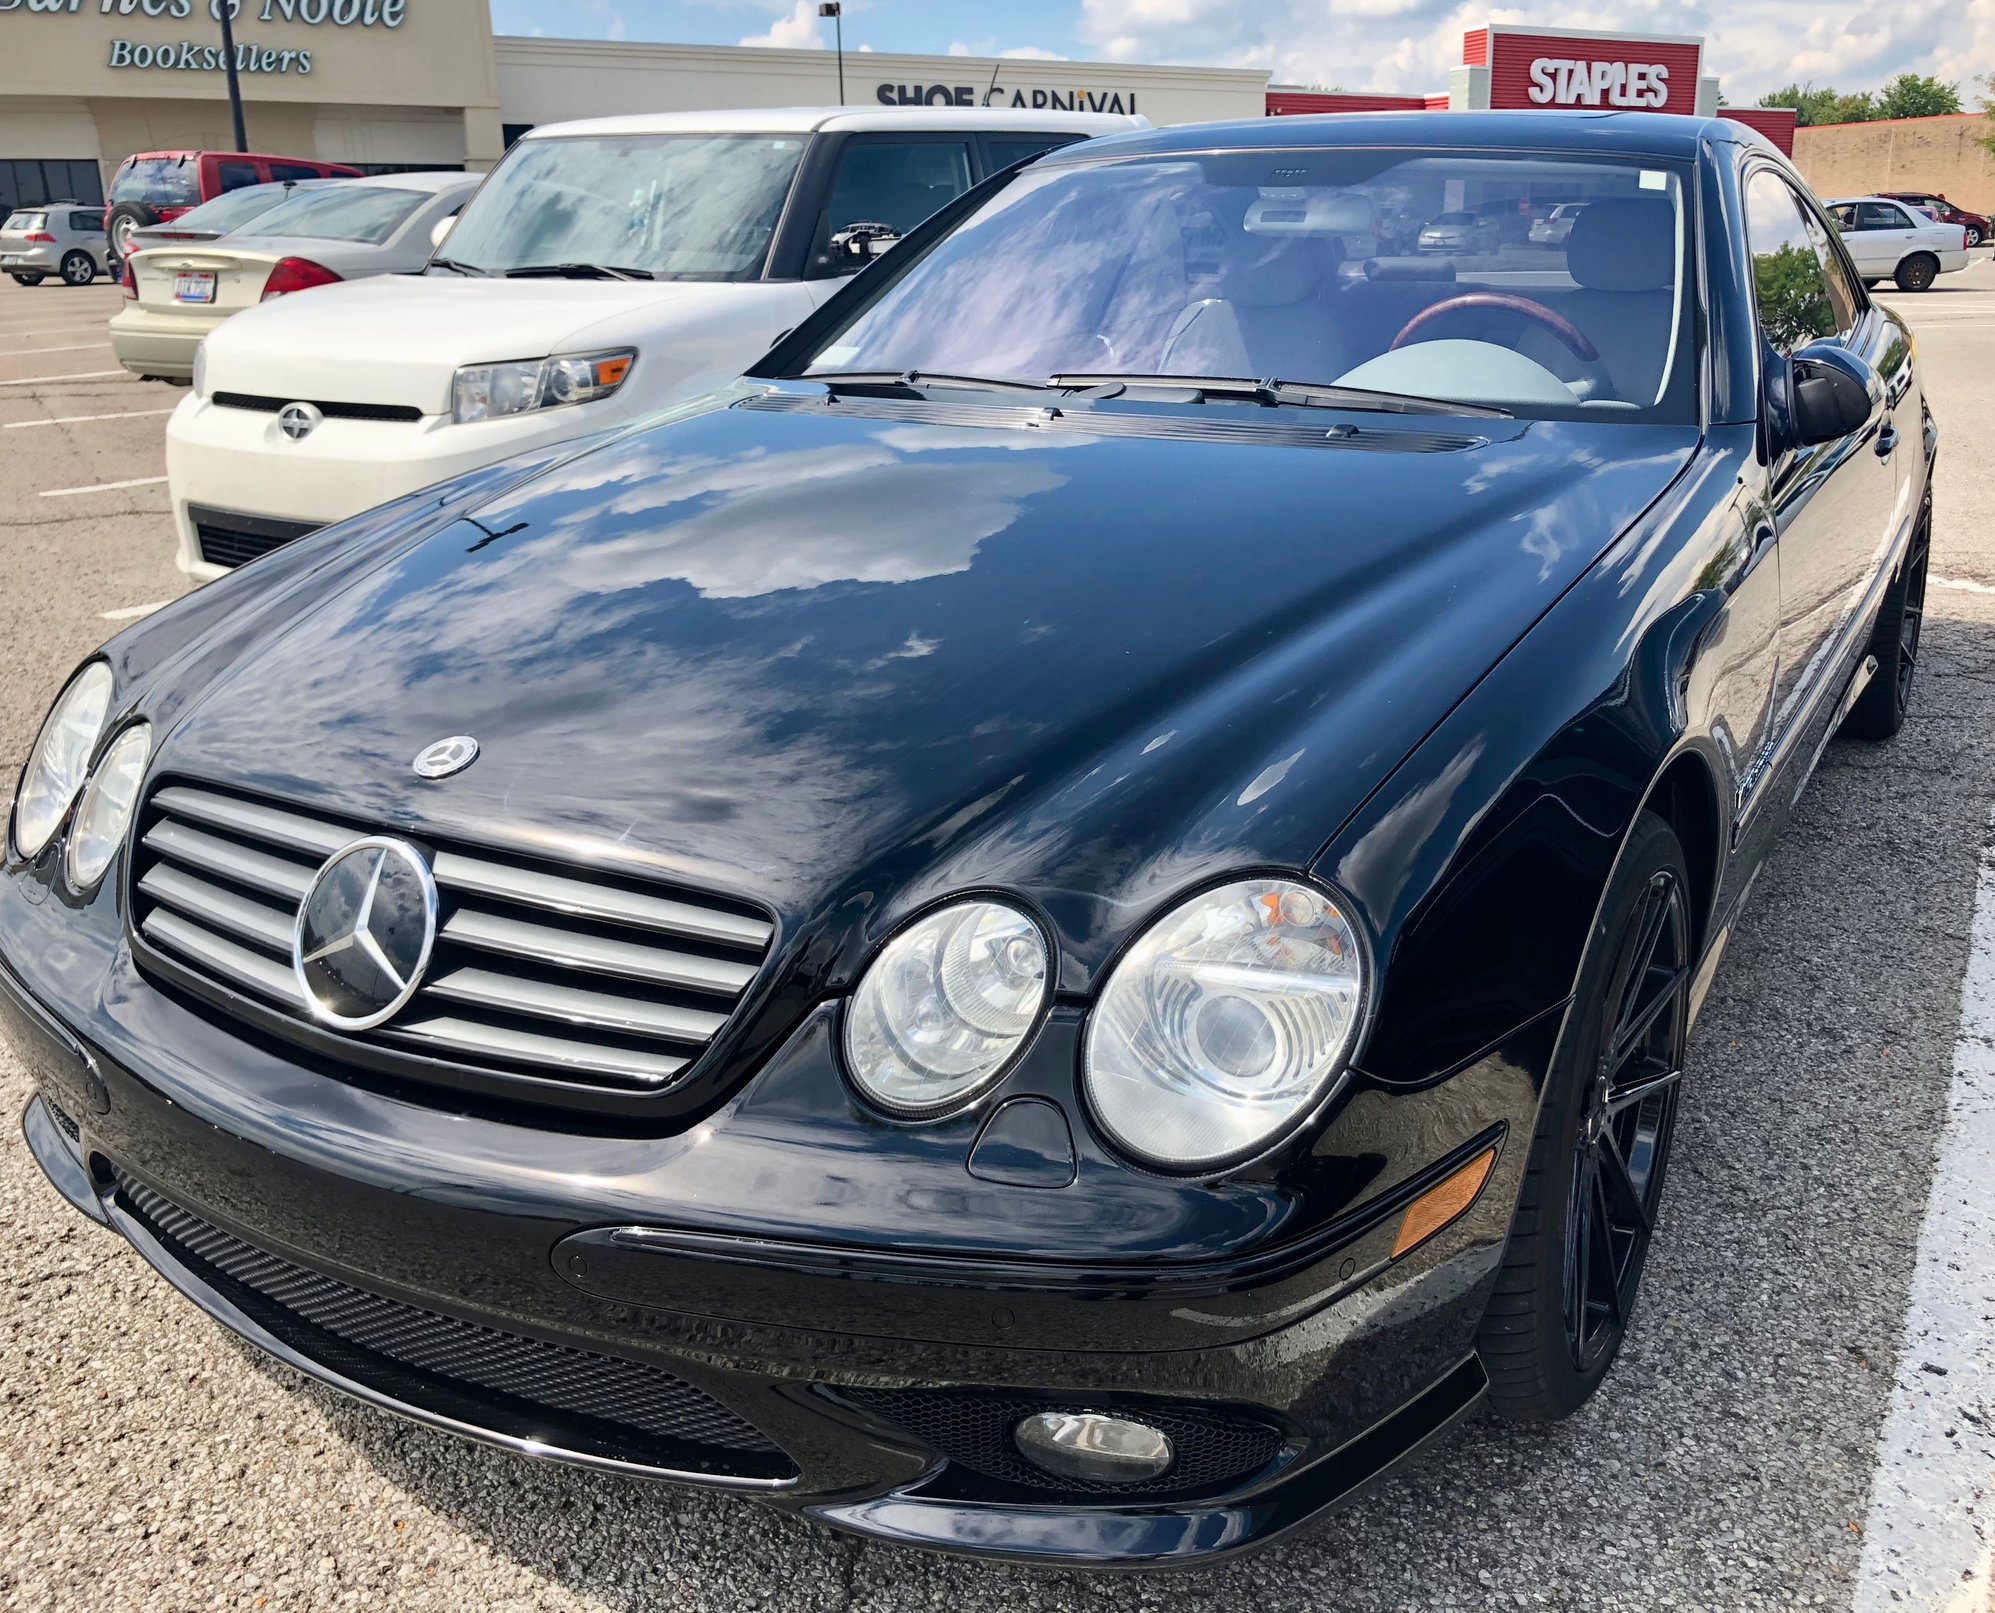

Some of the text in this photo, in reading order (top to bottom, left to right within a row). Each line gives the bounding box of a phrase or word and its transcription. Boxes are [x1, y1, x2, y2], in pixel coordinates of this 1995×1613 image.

[108, 39, 312, 74] Booksellers
[877, 84, 974, 106] SHOE
[1528, 57, 1669, 108] STAPLES
